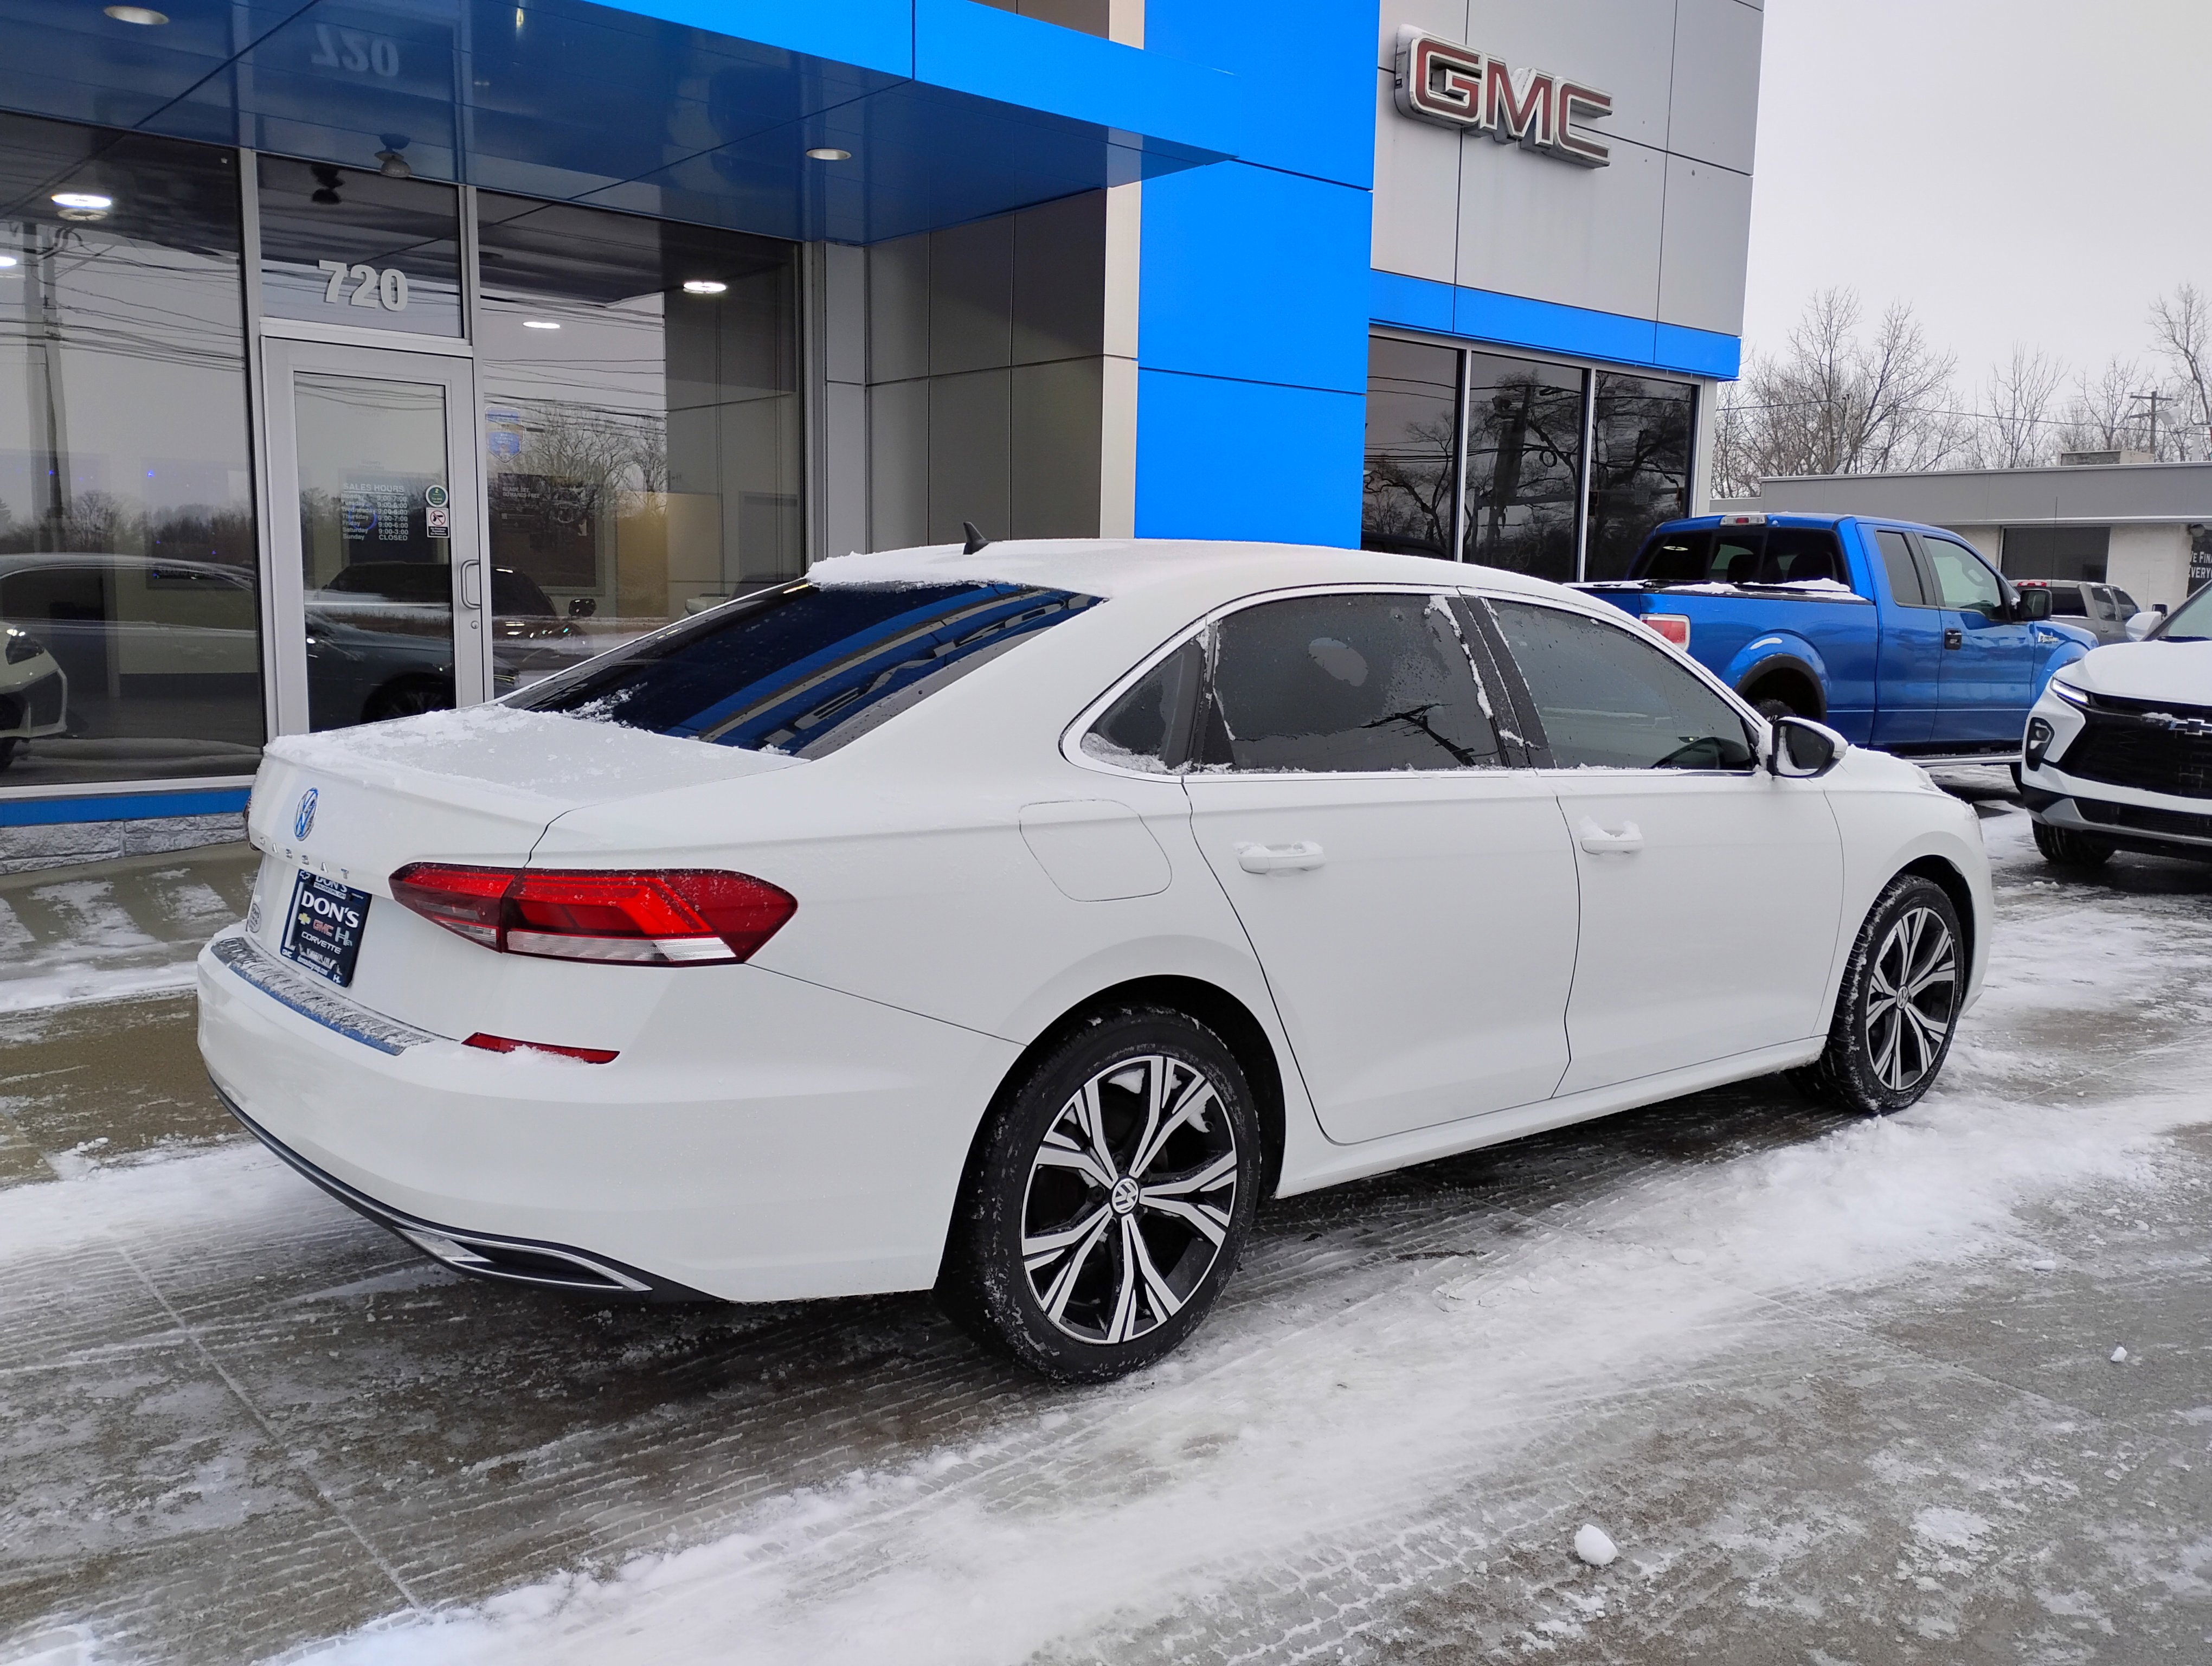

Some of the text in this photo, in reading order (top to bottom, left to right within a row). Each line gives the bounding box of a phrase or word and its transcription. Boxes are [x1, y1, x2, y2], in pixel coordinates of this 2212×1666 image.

[1403, 34, 1613, 166] GMC
[318, 259, 408, 311] 720
[374, 484, 404, 492] HOURS
[2191, 551, 2197, 563] E
[2189, 566, 2212, 578] VERY
[260, 836, 350, 880] PASSAT
[301, 890, 359, 928] DON'S
[313, 919, 334, 937] GMC
[301, 931, 342, 954] CORVETTE
